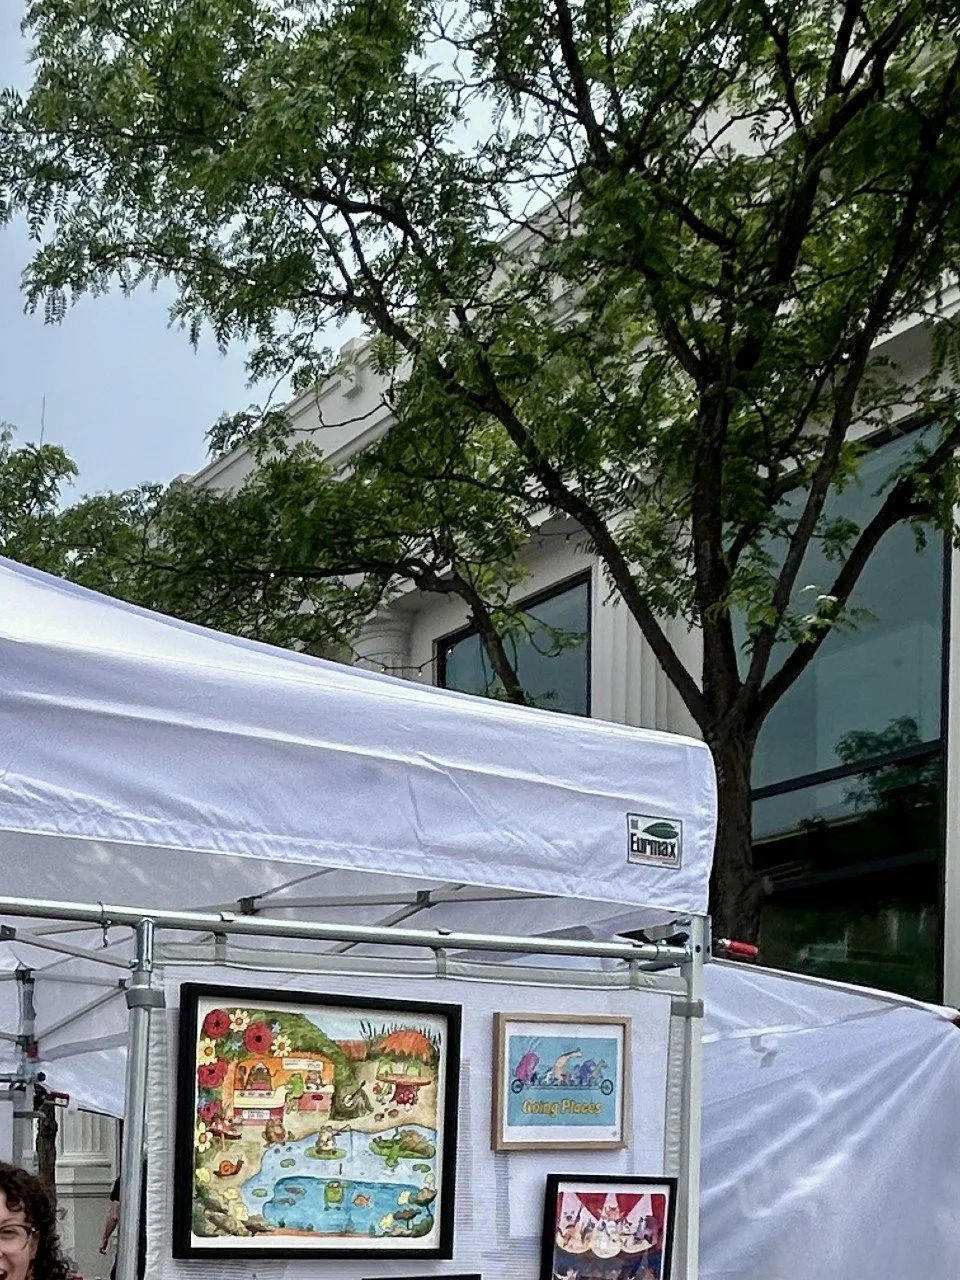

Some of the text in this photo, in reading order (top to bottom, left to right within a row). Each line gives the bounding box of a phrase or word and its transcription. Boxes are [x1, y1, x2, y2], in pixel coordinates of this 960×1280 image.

[630, 832, 677, 859] Eurmax
[523, 1099, 602, 1117] Going Places
